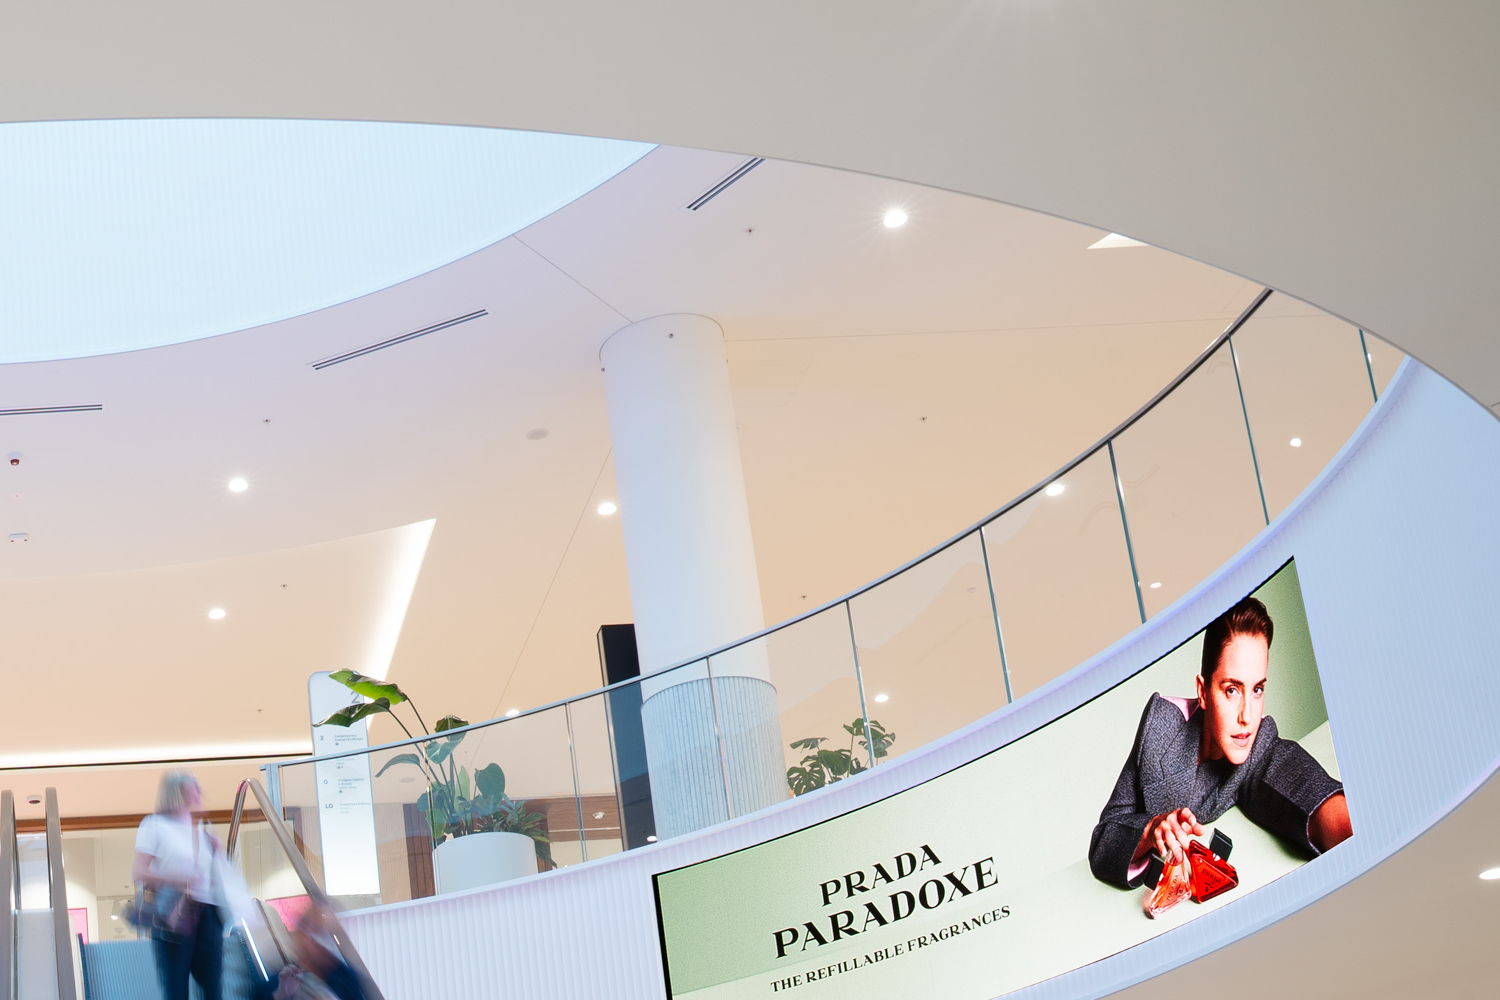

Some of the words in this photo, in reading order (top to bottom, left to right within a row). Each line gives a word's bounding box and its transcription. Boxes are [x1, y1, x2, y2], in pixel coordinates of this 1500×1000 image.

[350, 690, 361, 704] 2
[772, 856, 999, 959] PARADOXE
[819, 844, 942, 907] PRADA
[770, 974, 803, 992] THE
[805, 943, 905, 984] REFILLABLE
[907, 905, 1011, 953] FRAGRANCES
